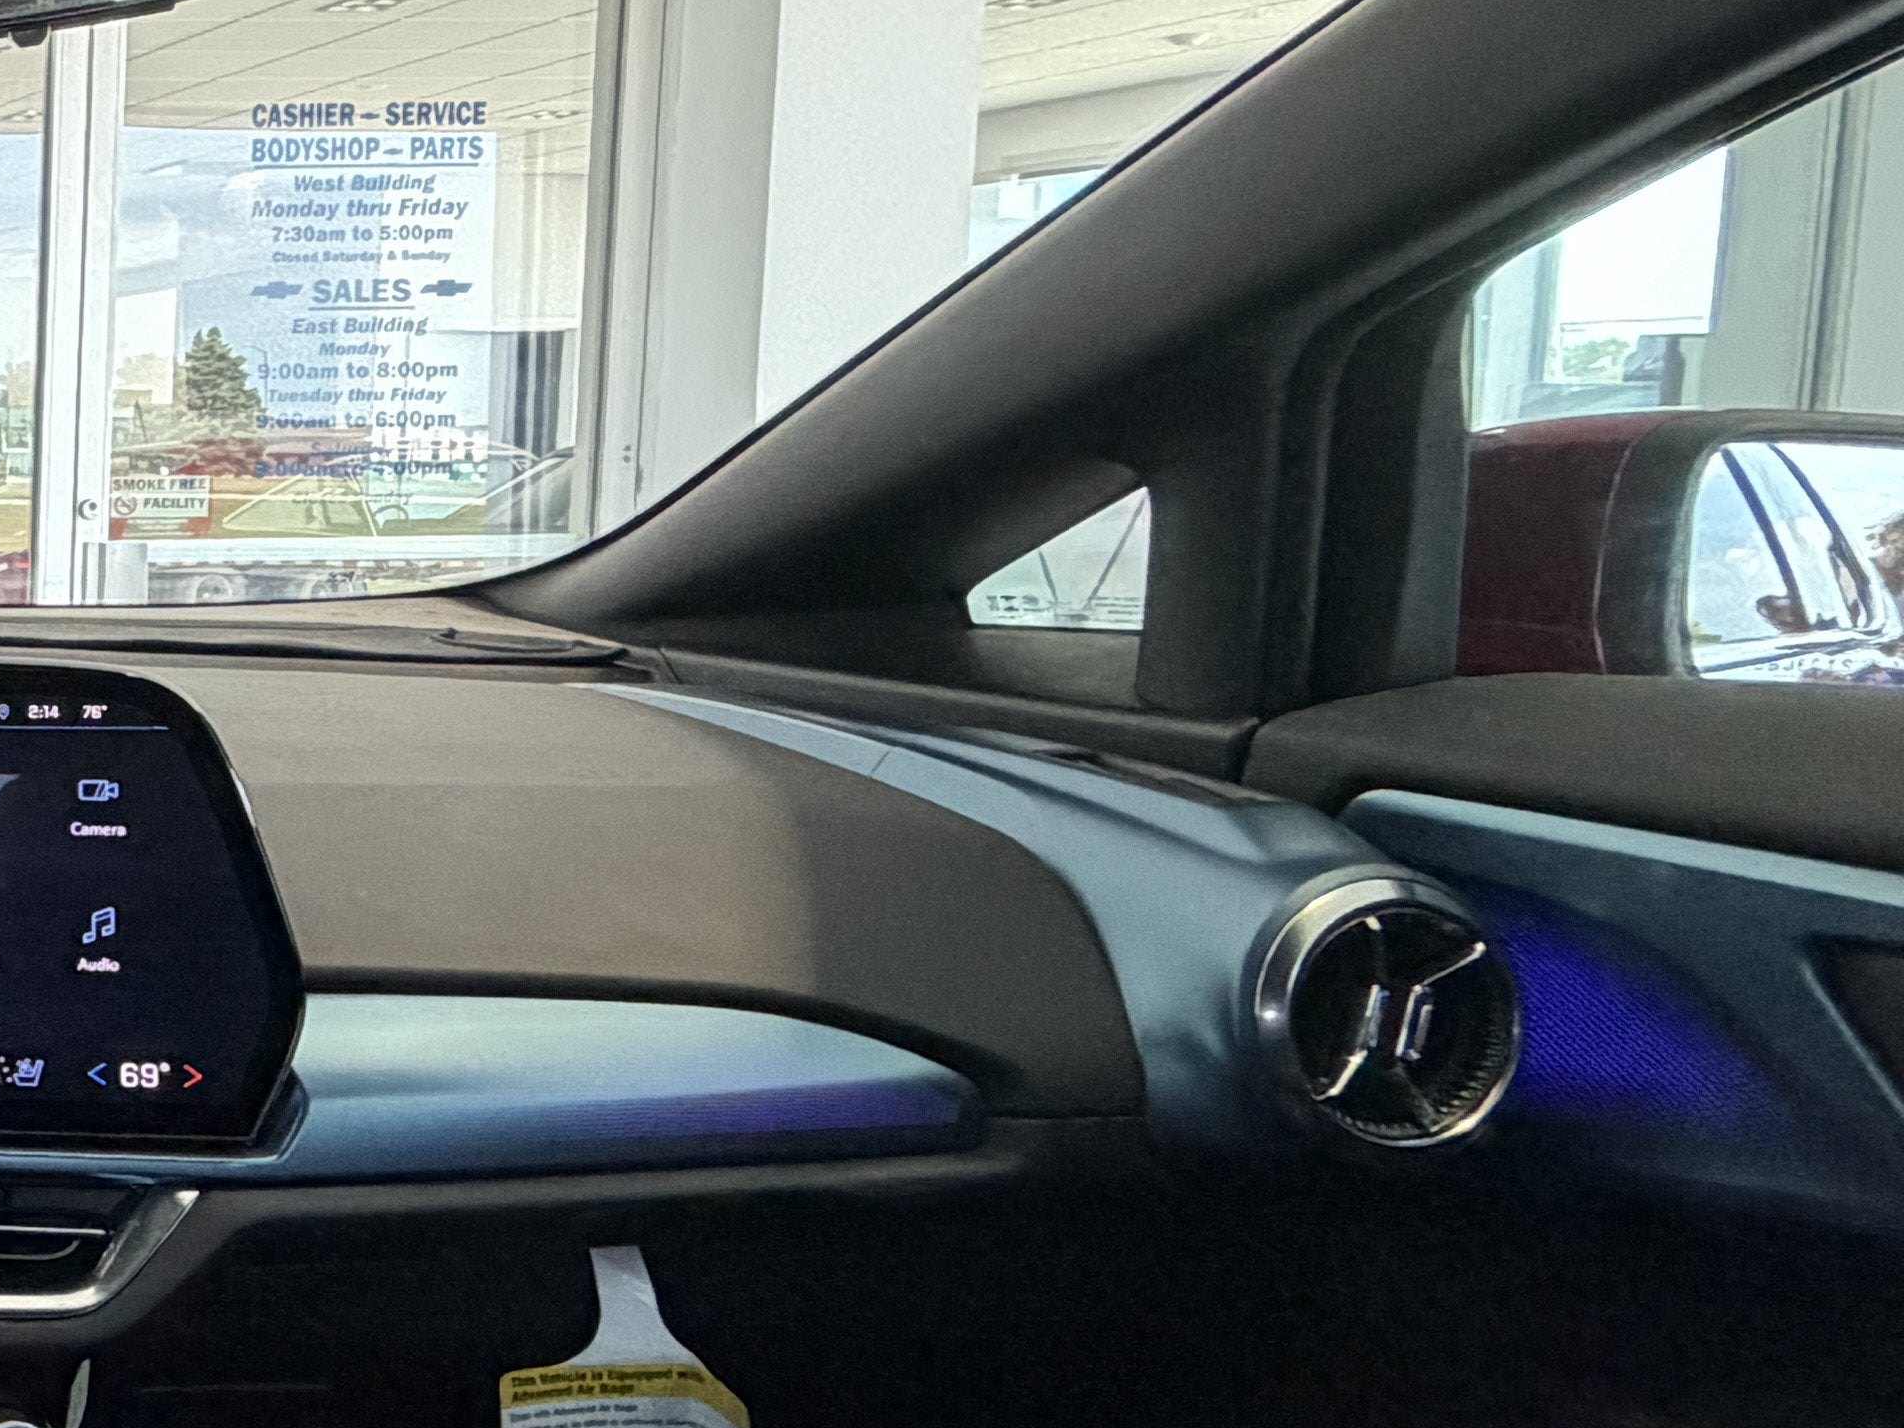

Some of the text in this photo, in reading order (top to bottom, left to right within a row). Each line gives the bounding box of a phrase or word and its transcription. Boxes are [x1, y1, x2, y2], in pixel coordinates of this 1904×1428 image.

[252, 101, 488, 128] CASHIER SERVICE
[251, 136, 484, 163] BODYSHOP PARTS
[294, 173, 437, 194] West Building
[251, 198, 469, 221] Monday thru Friday
[271, 225, 453, 245] 7:30am to 5:00pm
[272, 250, 319, 263] Closed
[323, 250, 383, 265] Saturday
[312, 278, 412, 305] SALES
[291, 316, 430, 336] East Building
[319, 341, 391, 358] Monday
[258, 363, 459, 382] 9:00am to 8:00pm
[268, 387, 447, 404] Tuesday thru Friday
[345, 412, 367, 429] to
[375, 410, 457, 430] 6:00pm
[113, 477, 206, 492] SMOKE FREE
[143, 497, 206, 510] FACILITY
[28, 704, 59, 719] 2:14
[70, 821, 127, 836] Camera
[77, 957, 120, 972] Audio
[120, 1061, 171, 1089] 69°
